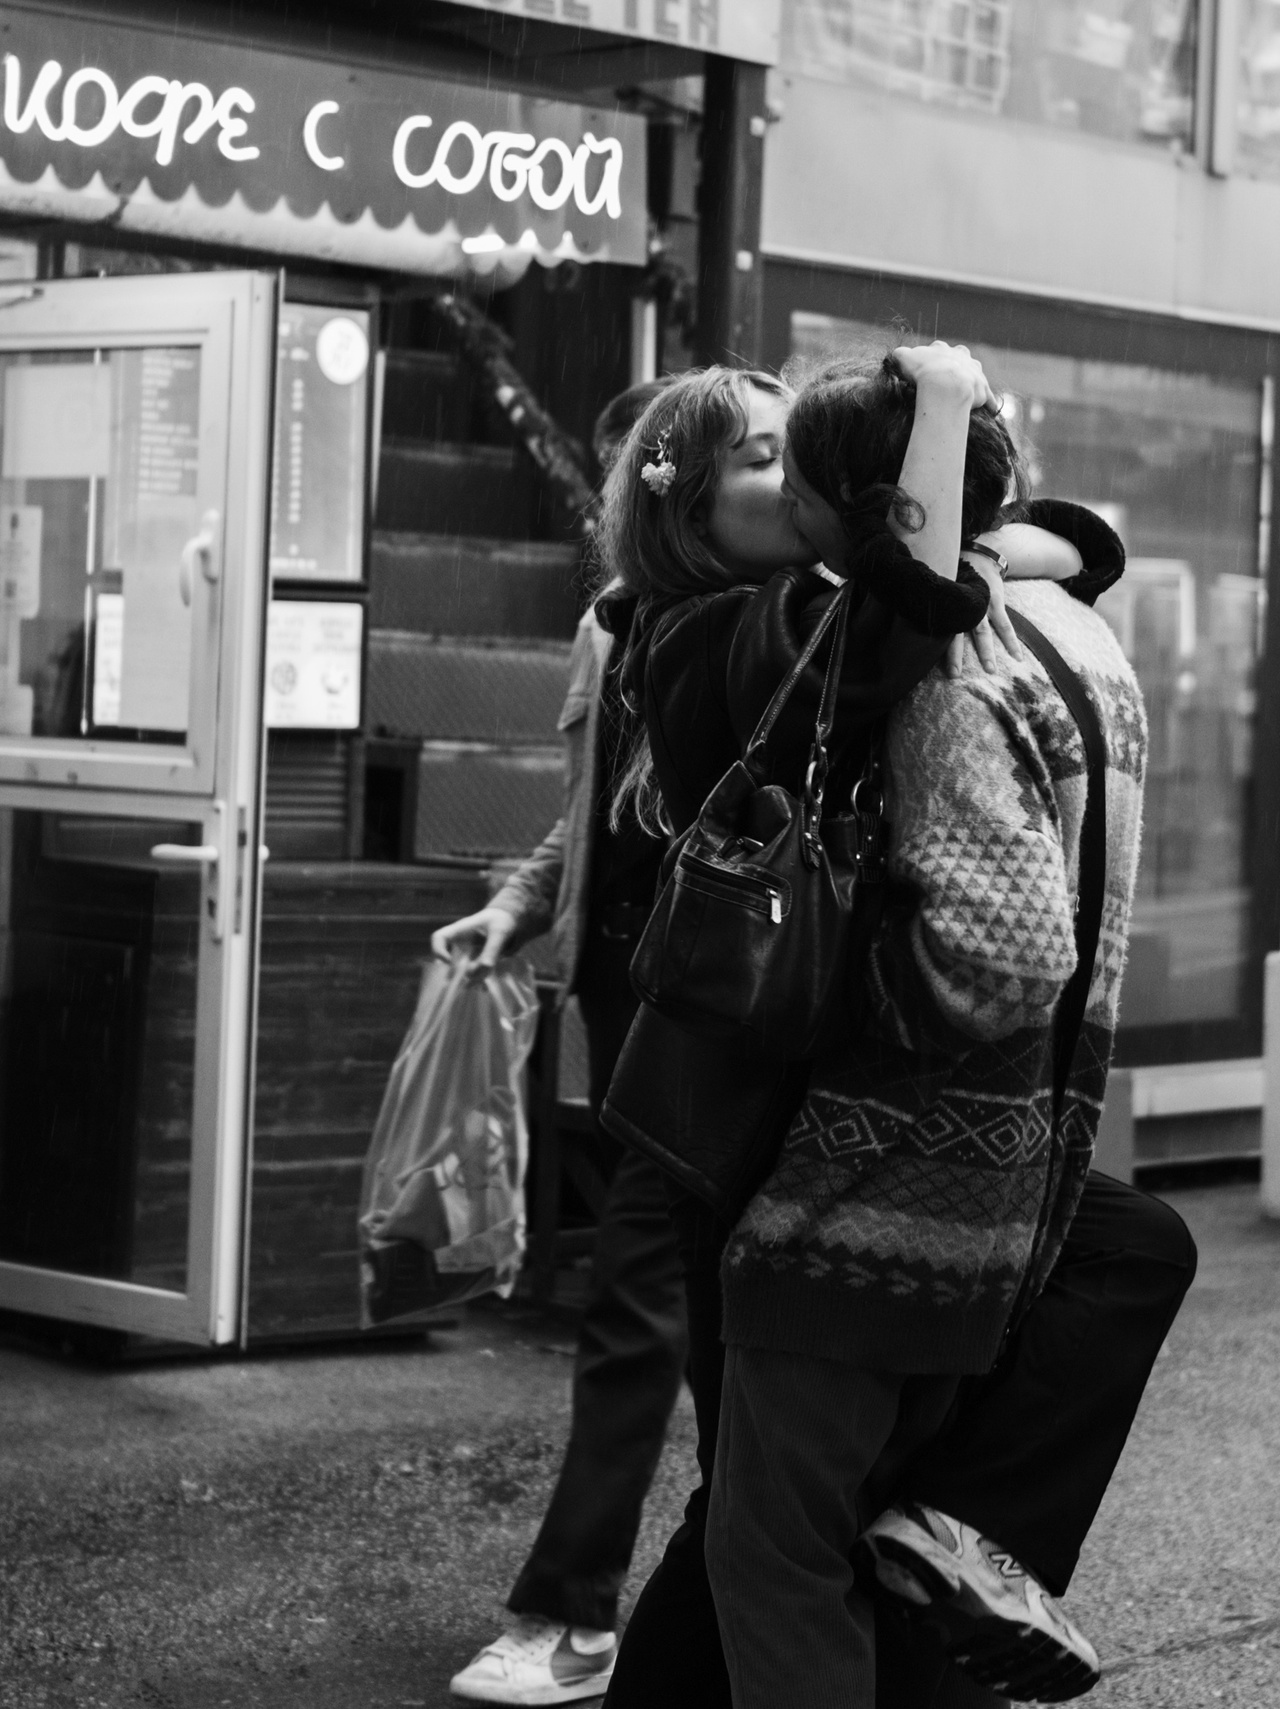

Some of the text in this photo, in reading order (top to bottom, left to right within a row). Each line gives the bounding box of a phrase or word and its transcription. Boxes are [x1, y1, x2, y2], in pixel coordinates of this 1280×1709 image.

[4, 54, 624, 219] кофе с собой
